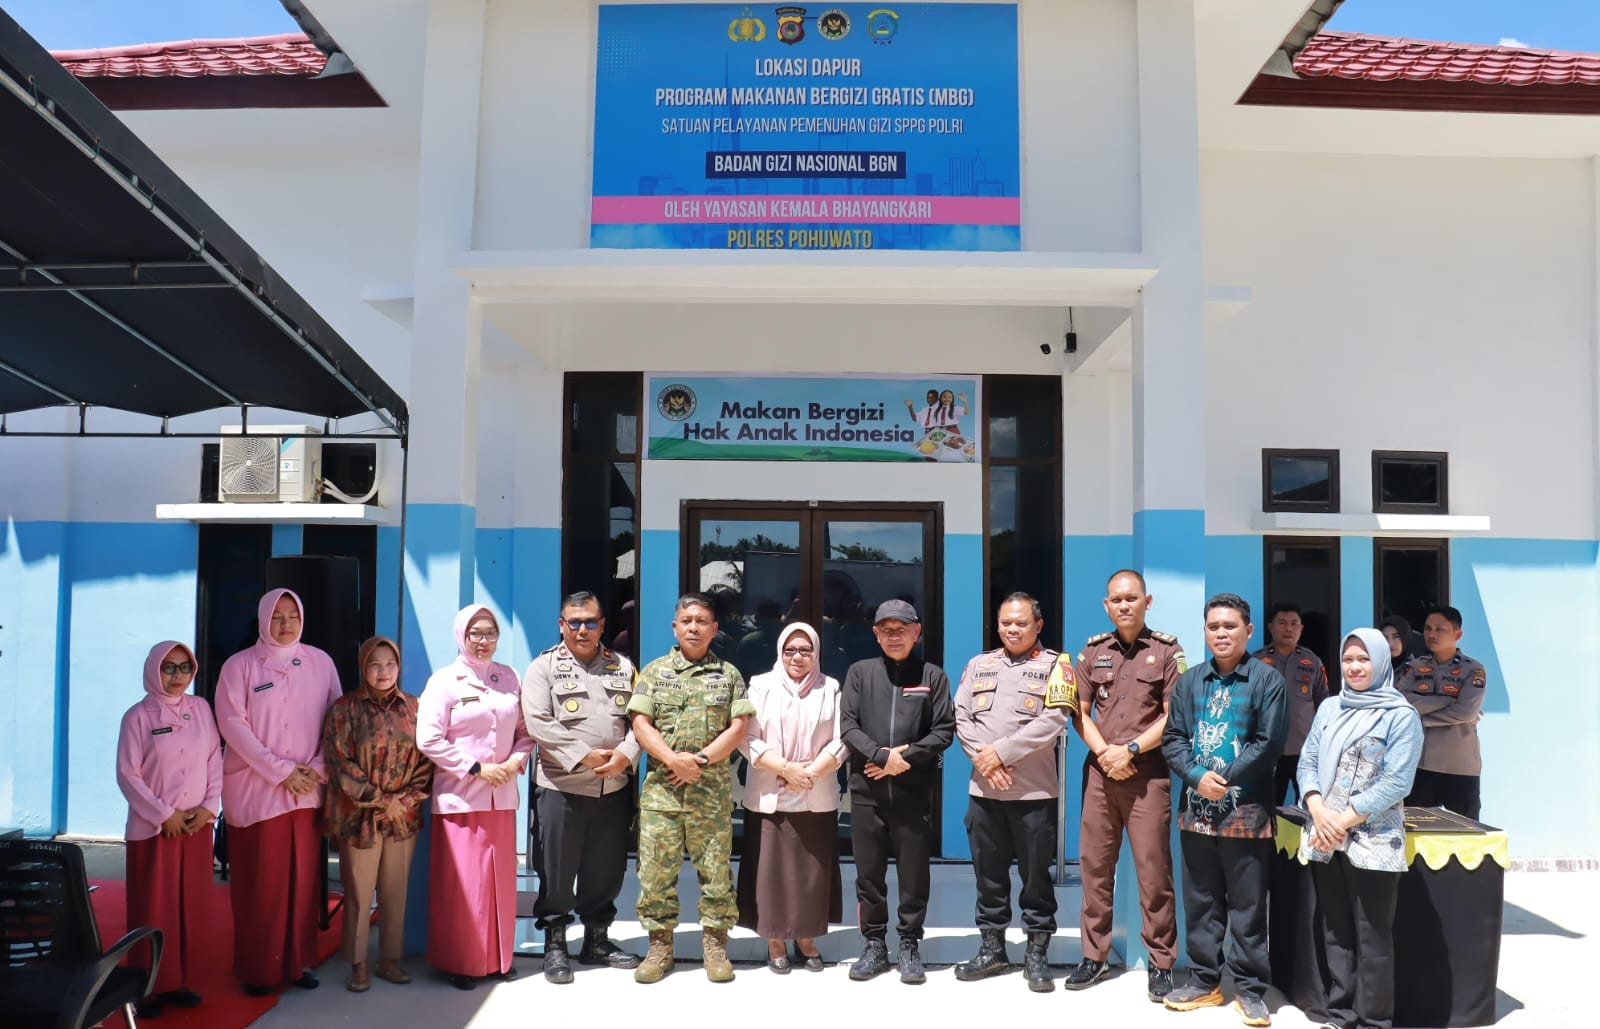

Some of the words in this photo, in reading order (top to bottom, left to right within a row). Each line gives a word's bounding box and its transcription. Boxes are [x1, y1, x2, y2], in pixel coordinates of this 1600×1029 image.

[755, 58, 807, 76] LOKASI
[812, 58, 861, 76] DAPUR
[655, 87, 727, 106] PROGRAM
[731, 87, 806, 105] MAKANAN
[810, 87, 867, 105] BERGIZI
[871, 87, 924, 106] GRATIS
[928, 88, 975, 106] (MBG)
[661, 118, 710, 134] SATUAN
[713, 118, 787, 133] PELAYANAN
[790, 117, 866, 133] PEMENUHAN
[869, 118, 891, 133] GIZI
[894, 118, 926, 133] SPPG
[929, 119, 963, 134] POLRI
[714, 155, 762, 172] BADAN
[765, 155, 792, 172] GIZI
[796, 155, 865, 172] NASIONAL
[869, 155, 897, 172] BGN
[664, 200, 700, 218] OLEH
[703, 200, 767, 218] YAYASAN
[770, 200, 829, 218] KEMALA
[832, 200, 932, 218] BHAYANGKARI
[727, 229, 785, 248] POLRES
[788, 229, 873, 249] POHUWATO
[719, 400, 801, 420] Makan
[808, 402, 885, 426] Bergizi
[683, 421, 731, 440] Hak
[736, 421, 799, 441] Anak
[805, 422, 915, 442] Indonesia
[655, 680, 682, 690] ARIFIN
